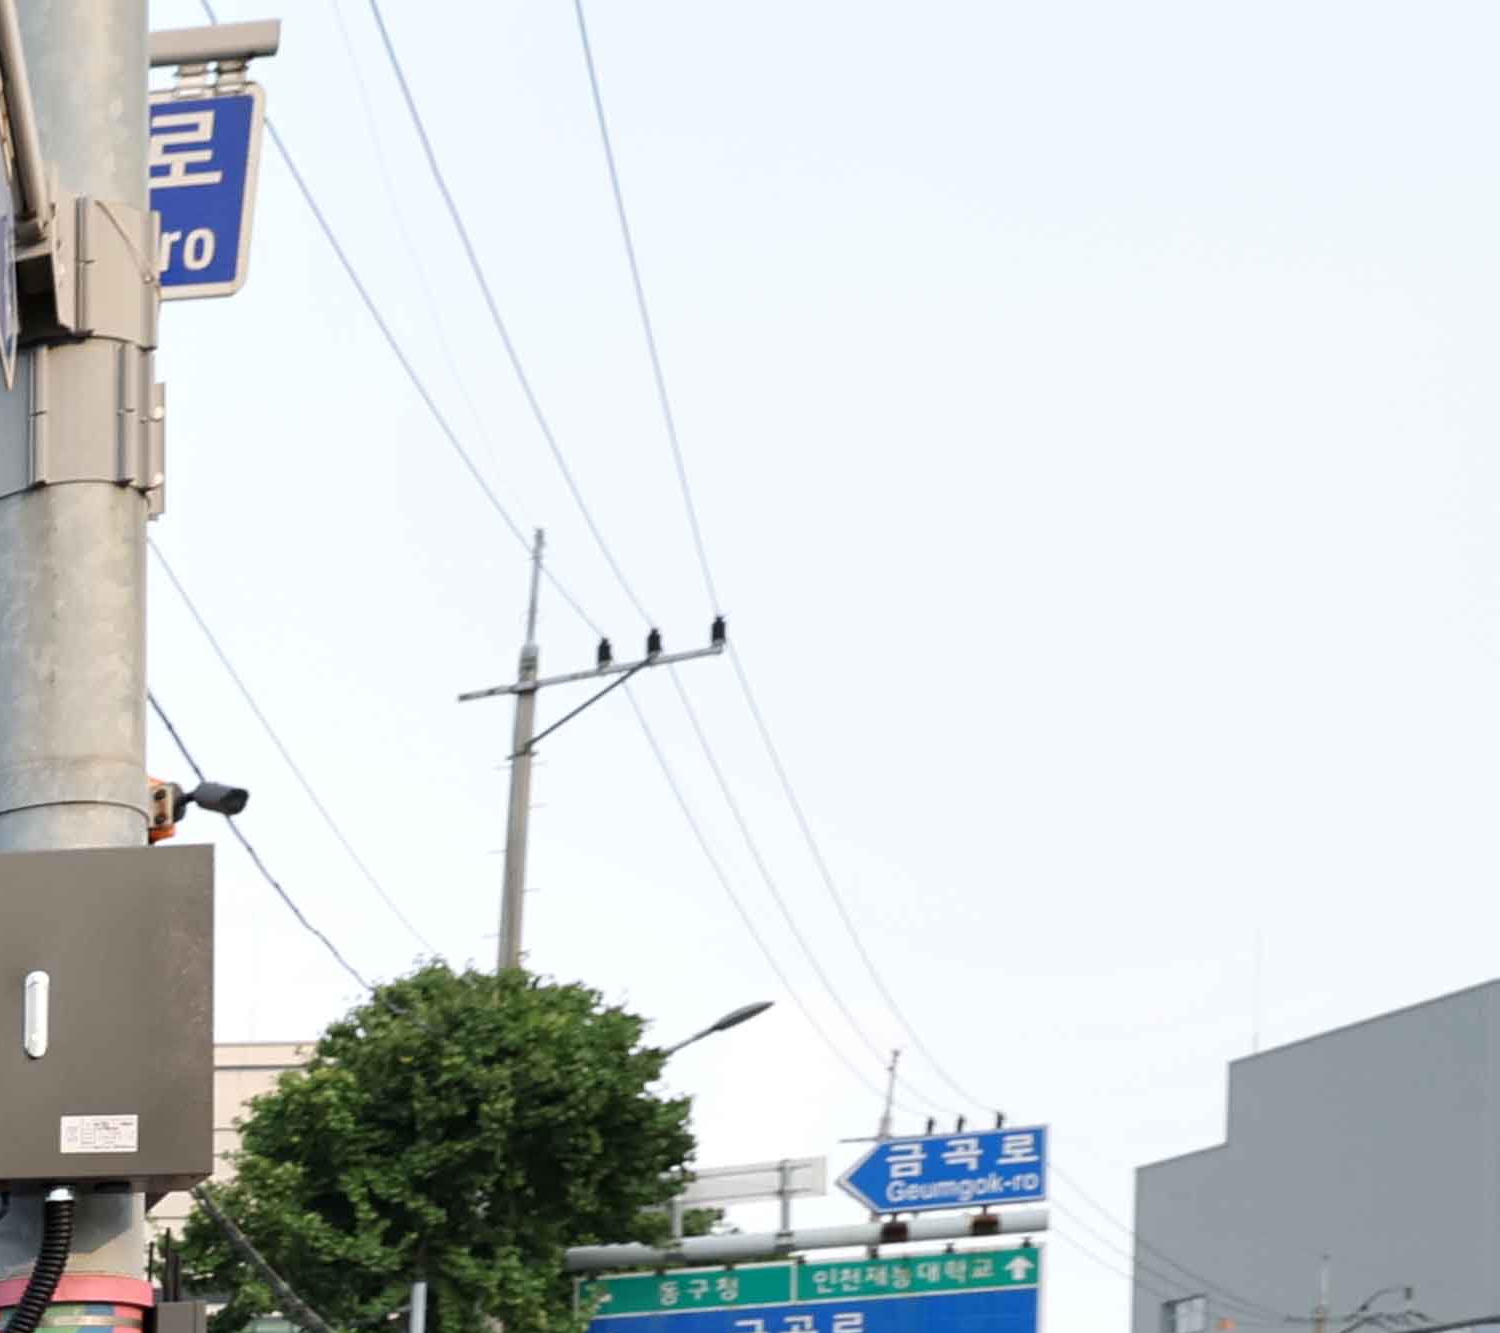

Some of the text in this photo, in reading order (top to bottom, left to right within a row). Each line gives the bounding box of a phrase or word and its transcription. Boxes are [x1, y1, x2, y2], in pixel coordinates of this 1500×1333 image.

[886, 1133, 1041, 1178] 금곡로
[886, 1171, 1040, 1203] Geumgok-ro
[658, 1277, 740, 1304] 동구청
